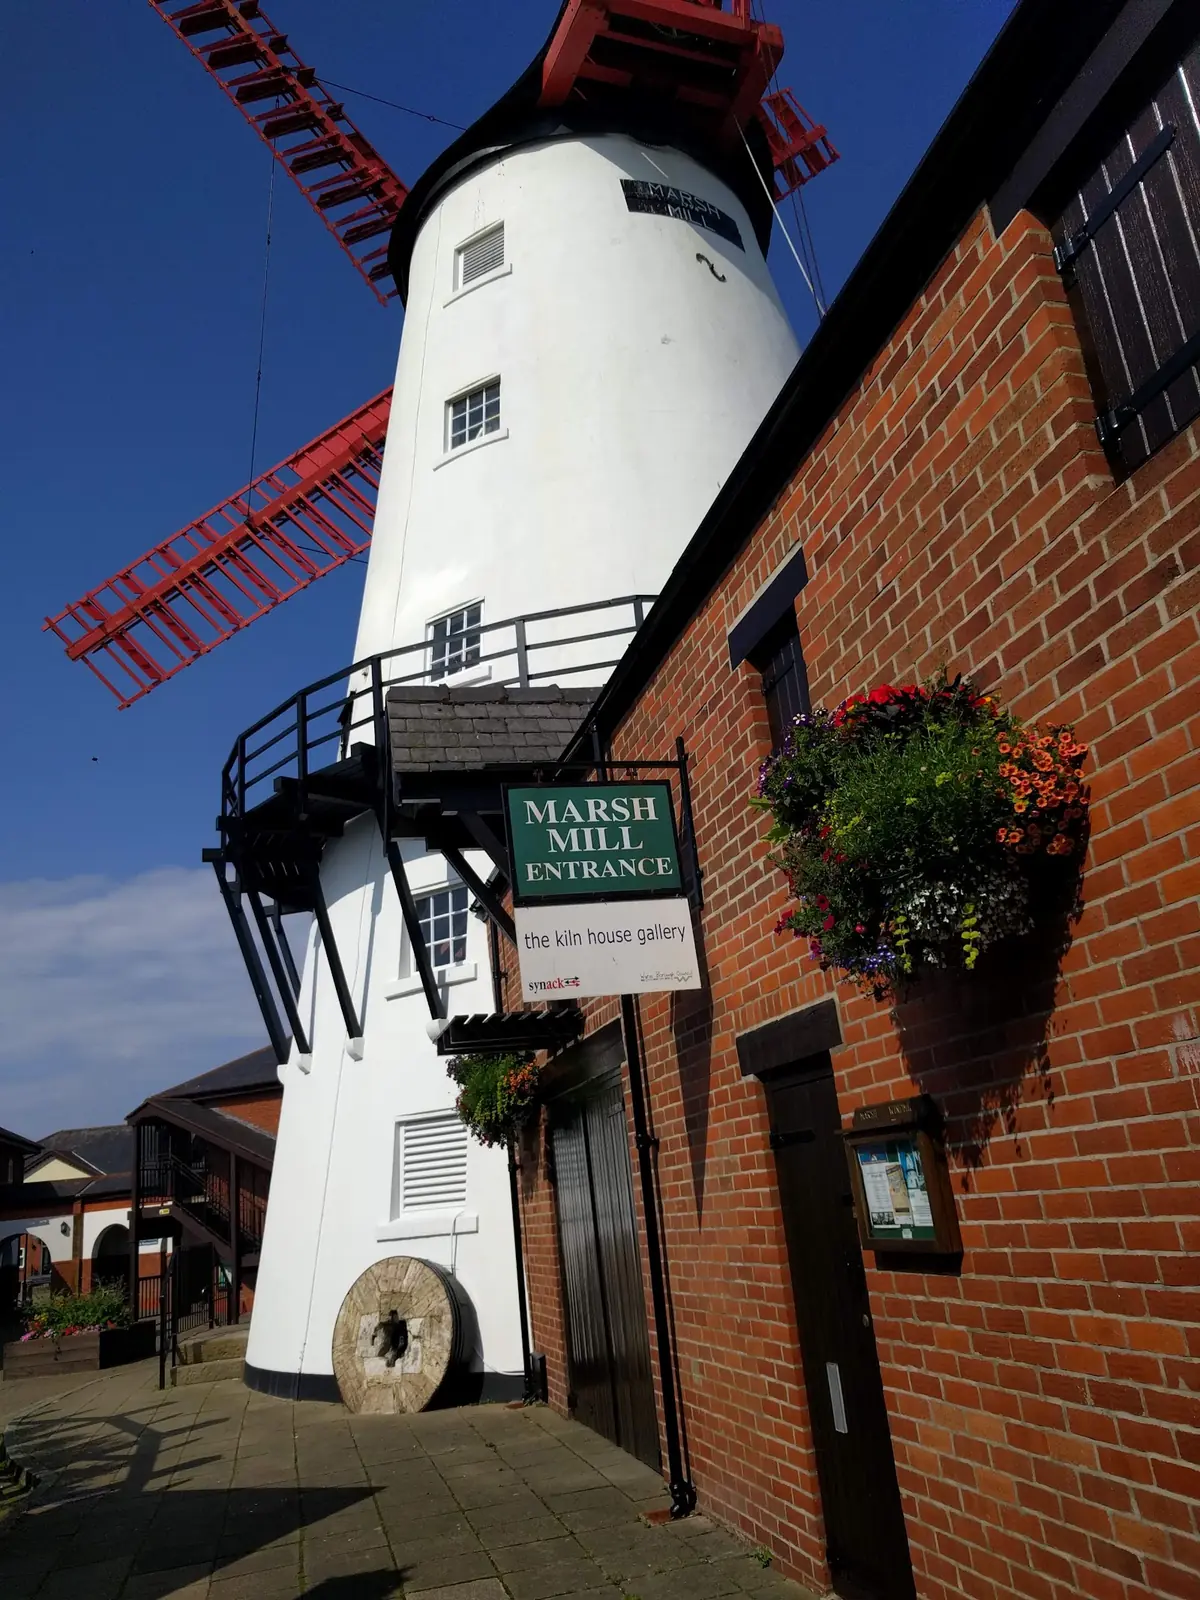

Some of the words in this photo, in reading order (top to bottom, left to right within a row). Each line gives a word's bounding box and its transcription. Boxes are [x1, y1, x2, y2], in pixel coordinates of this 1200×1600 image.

[648, 182, 721, 220] MARSH
[667, 203, 716, 232] MILL
[523, 797, 659, 825] MARSH
[546, 826, 644, 853] MILL
[525, 857, 674, 882] ENTRANCE
[524, 931, 551, 949] the
[555, 930, 582, 947] kiln
[587, 928, 632, 945] house
[637, 924, 686, 945] gallery
[528, 977, 566, 994] synack
